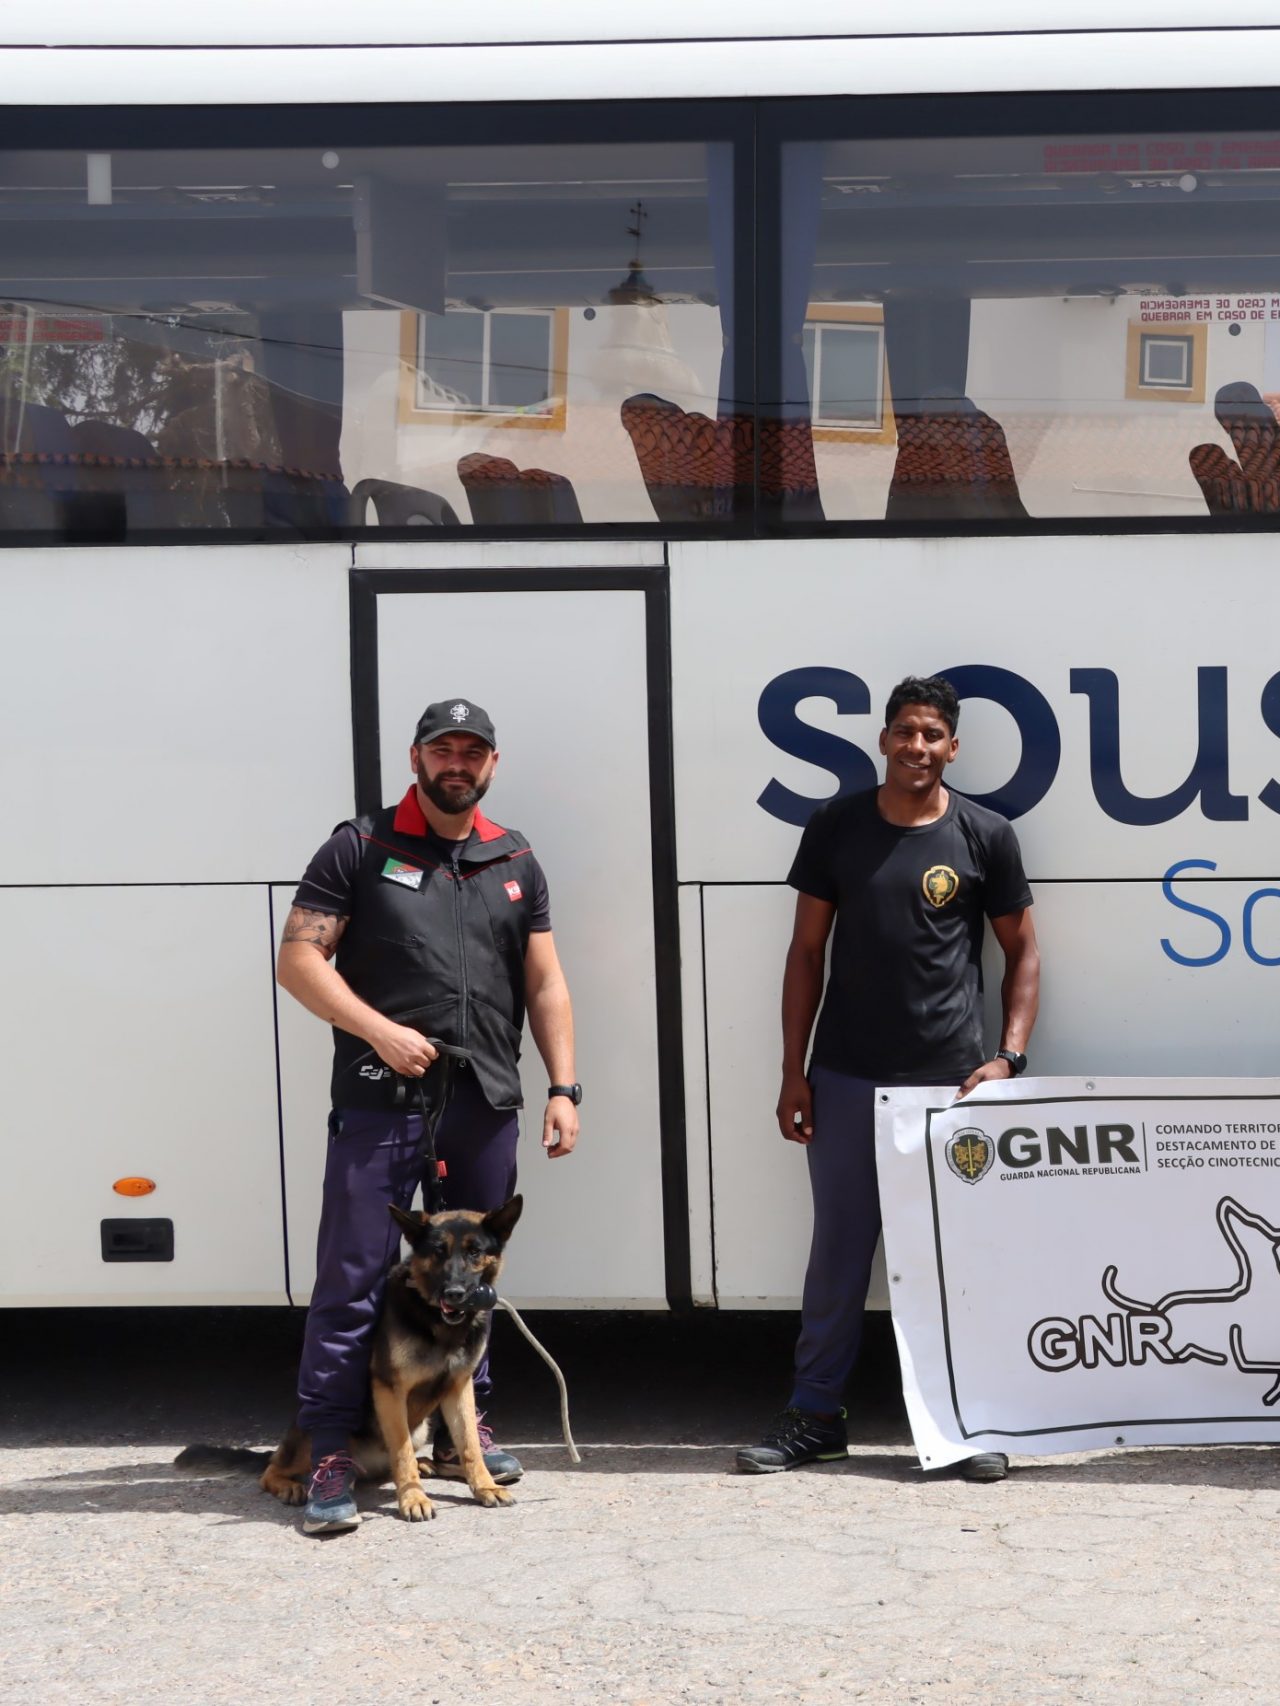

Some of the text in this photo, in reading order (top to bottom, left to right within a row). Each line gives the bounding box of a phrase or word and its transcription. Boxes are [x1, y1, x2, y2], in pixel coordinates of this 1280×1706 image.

[1141, 311, 1191, 322] QUEBRAR
[1196, 311, 1212, 321] EM
[1218, 310, 1246, 320] CASO
[1250, 310, 1265, 320] DE
[1155, 1124, 1222, 1135] COMANDO
[997, 1123, 1140, 1168] GNR
[1156, 1140, 1257, 1151] DESTACAMENTO
[1260, 1140, 1276, 1150] DE
[1157, 1155, 1205, 1170] SECÇÃO
[1000, 1166, 1141, 1181] GUARDA NACIONAL REPUBLICANA
[1027, 1312, 1176, 1373] GNR
